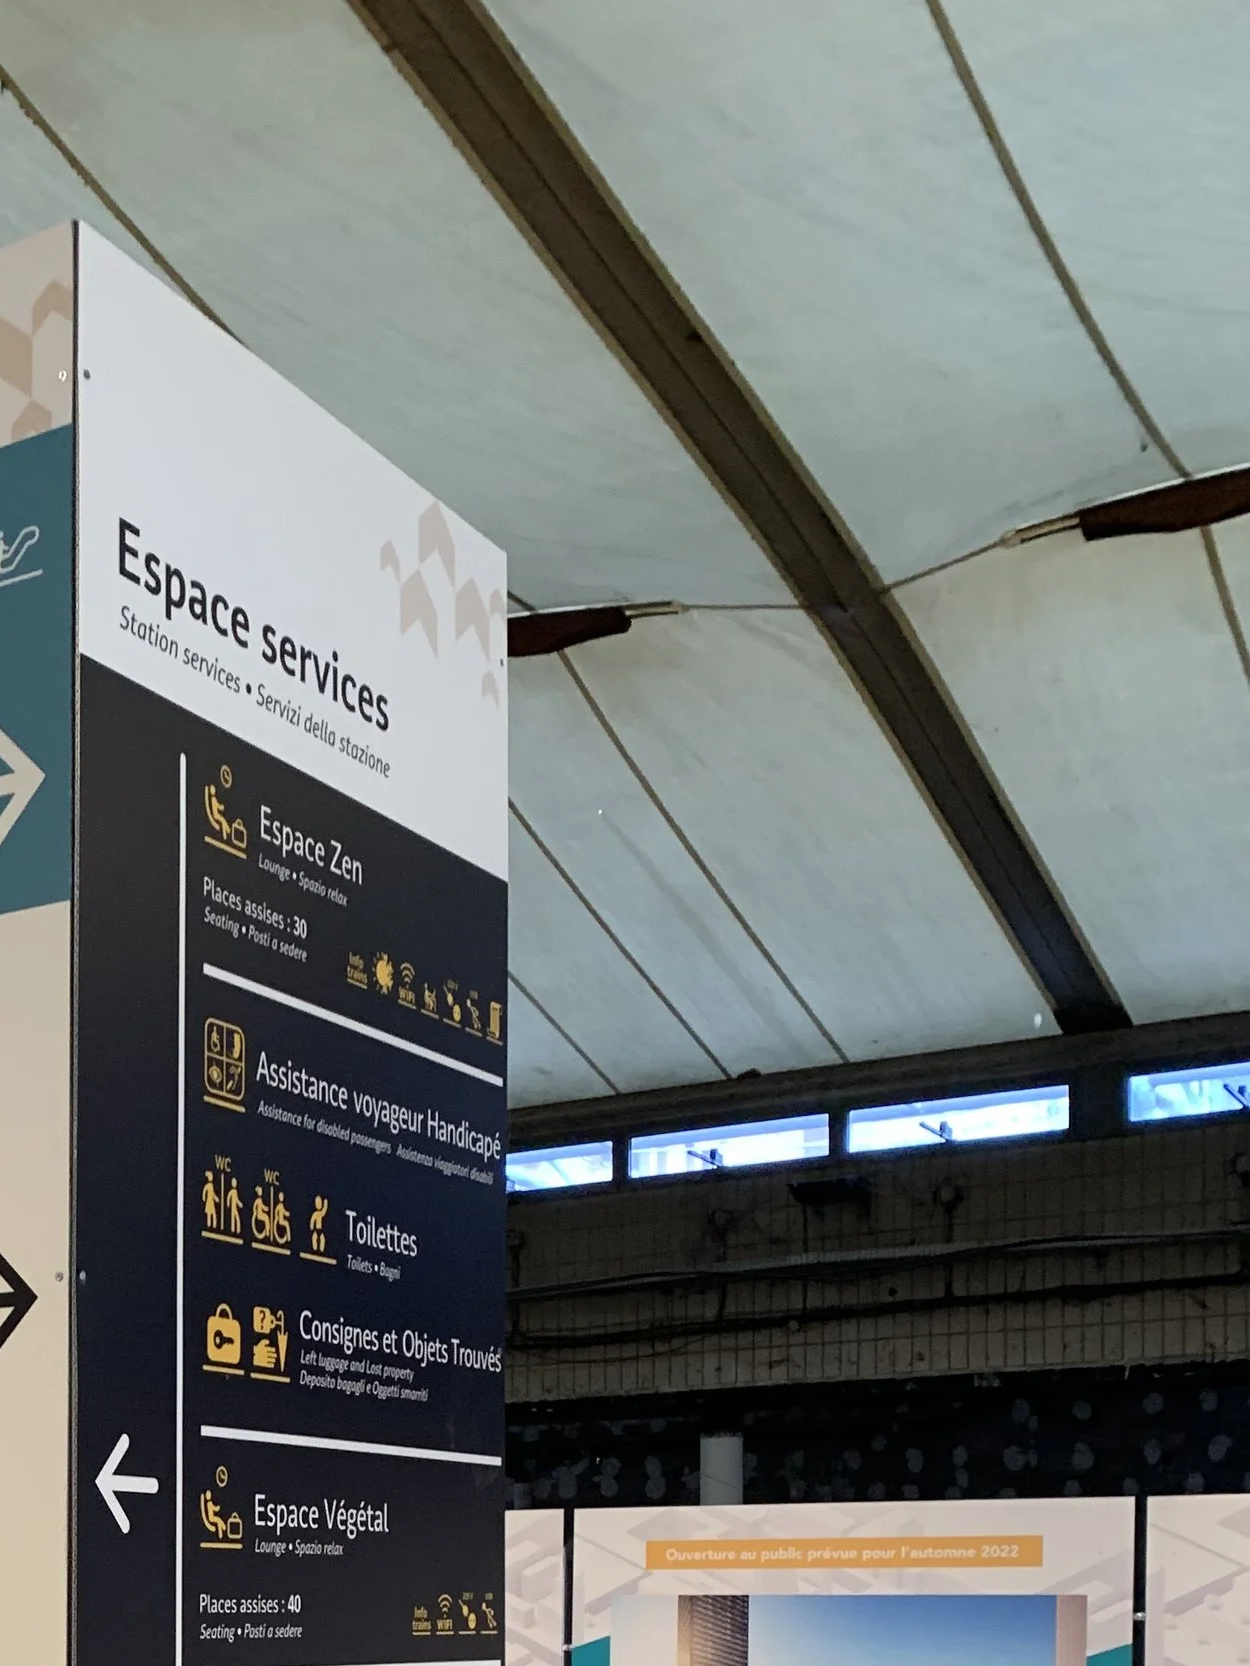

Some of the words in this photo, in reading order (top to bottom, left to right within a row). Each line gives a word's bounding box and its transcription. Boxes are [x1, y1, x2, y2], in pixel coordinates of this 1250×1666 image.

[119, 516, 250, 648] Espace
[262, 623, 390, 732] services
[260, 804, 325, 867] Espace
[330, 840, 363, 885] Zen
[258, 853, 290, 882] Lounge
[204, 876, 242, 912] Places
[245, 896, 285, 930] assises
[204, 907, 239, 938] Seating
[256, 1051, 348, 1110] Assistance
[353, 1089, 424, 1134] voyageur
[427, 1111, 501, 1162] Handicapé
[215, 1155, 231, 1172] WC
[351, 1131, 391, 1154] passengers
[346, 1209, 417, 1257] Toilettes
[300, 1310, 379, 1354] Consignes
[383, 1331, 397, 1354] et
[403, 1330, 448, 1367] Objets
[451, 1338, 501, 1373] Trouvés
[319, 1353, 349, 1373] luggage
[383, 1365, 414, 1383] property
[255, 1494, 319, 1535] Espace
[324, 1498, 389, 1539] Végétal
[666, 1547, 736, 1562] Ouverture
[739, 1550, 757, 1561] au
[761, 1547, 803, 1563] public
[807, 1546, 858, 1562] prévue
[862, 1548, 897, 1561] pour
[981, 1545, 1020, 1558] 2022
